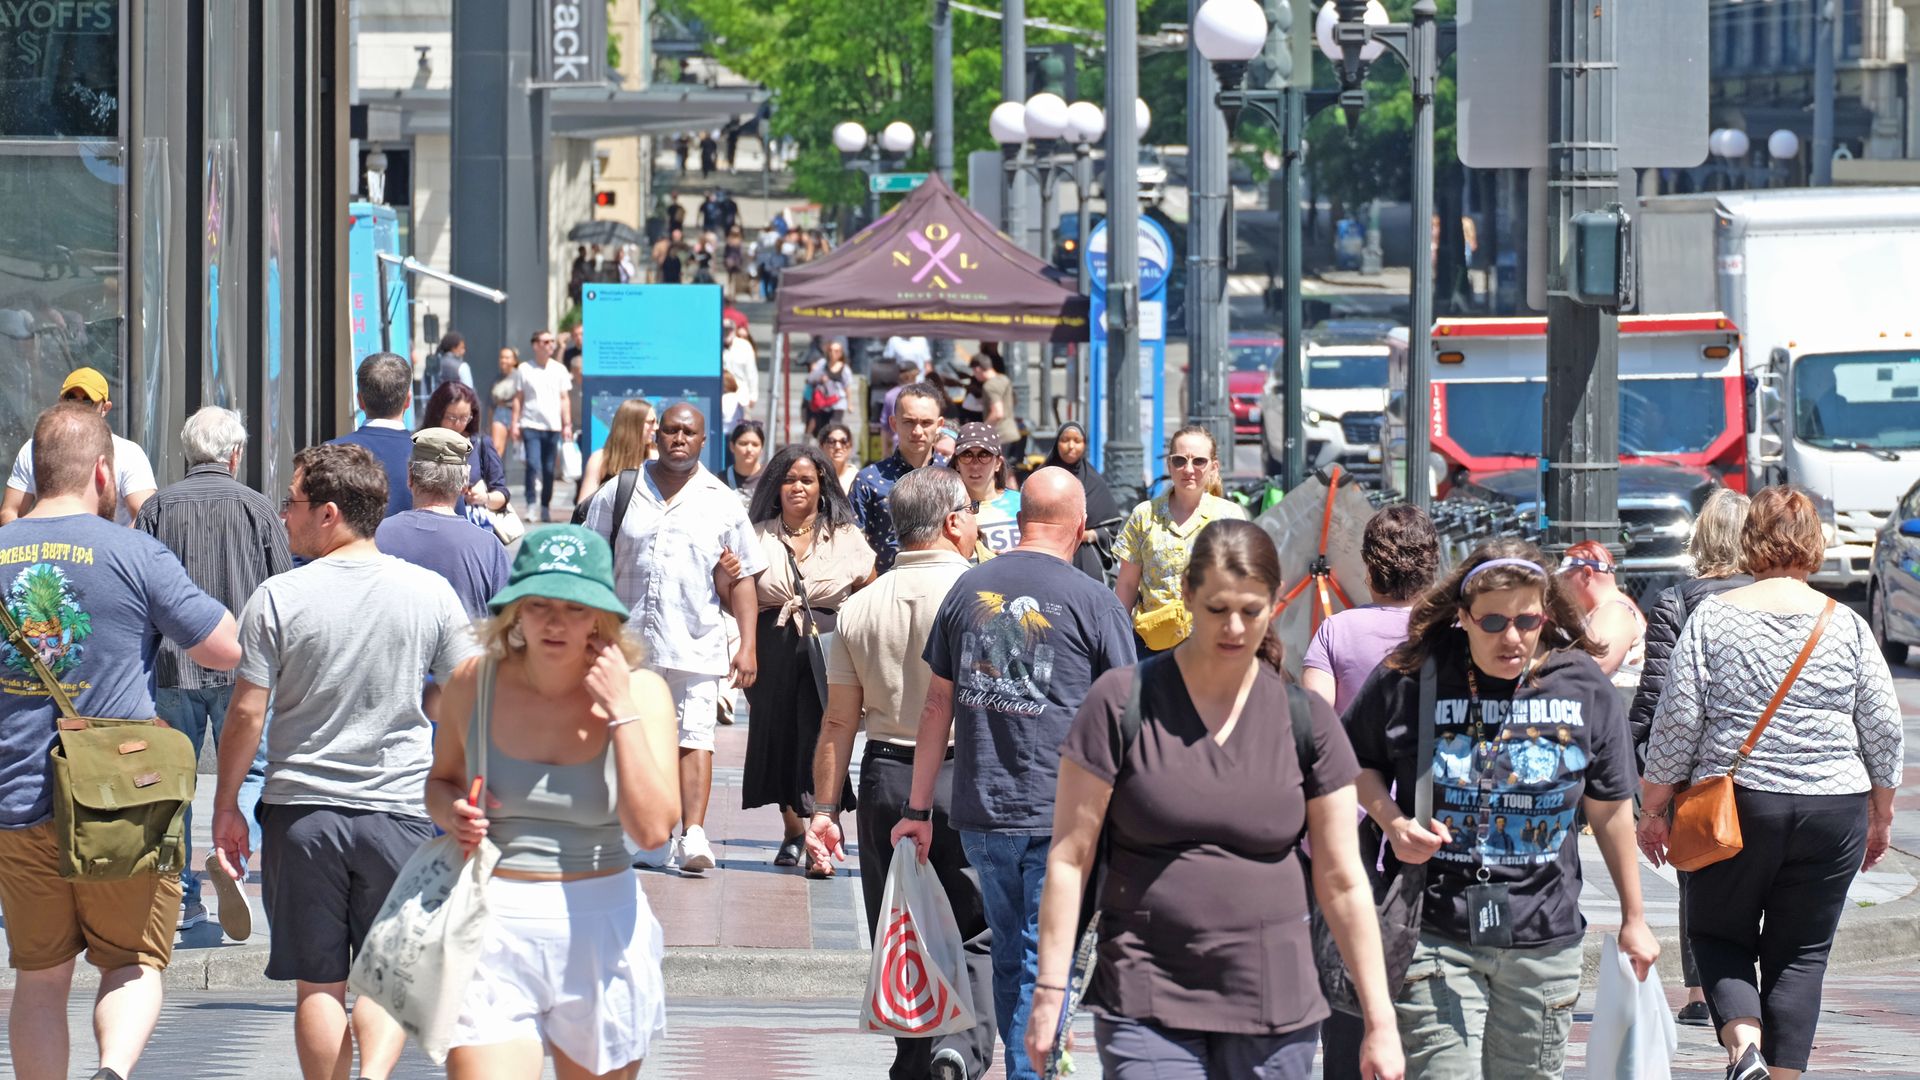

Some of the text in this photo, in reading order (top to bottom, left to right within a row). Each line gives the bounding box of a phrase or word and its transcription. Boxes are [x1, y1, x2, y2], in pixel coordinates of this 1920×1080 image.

[553, 0, 589, 80] ack
[1096, 267, 1162, 279] MAIL
[41, 541, 71, 561] BUTT
[71, 545, 94, 566] IPA
[1435, 698, 1584, 727] NEW IDS ON THE BLOCK
[1445, 789, 1564, 809] MIXTPE TOUR 2022
